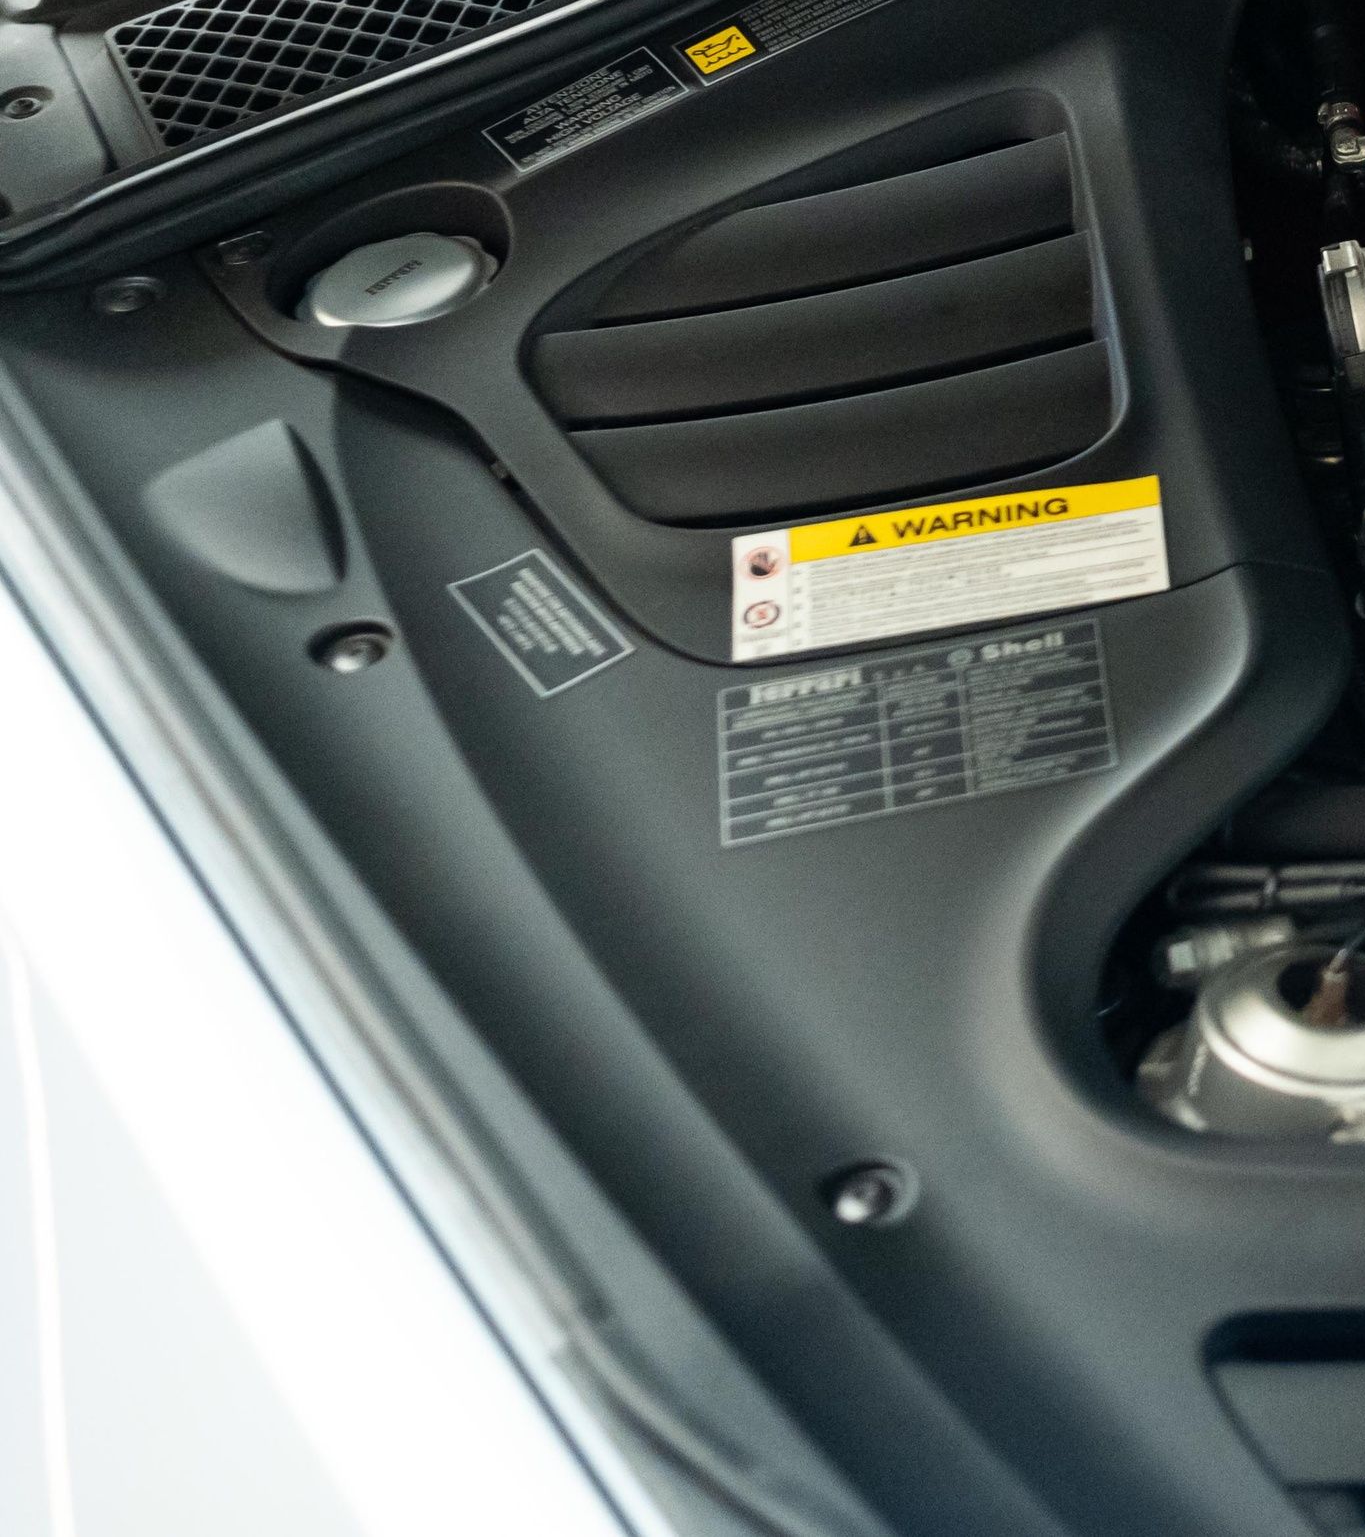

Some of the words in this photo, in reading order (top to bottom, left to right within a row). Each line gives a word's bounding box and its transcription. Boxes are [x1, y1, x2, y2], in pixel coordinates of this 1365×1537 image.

[520, 105, 555, 125] ALTA
[554, 69, 624, 107] TENSIONE
[524, 68, 610, 115] ATTENZIONE
[553, 93, 622, 130] WARNING
[543, 122, 581, 144] HIGH
[580, 91, 643, 125] VOLTAGE
[364, 259, 423, 295] Ferrari
[892, 497, 1070, 539] WARNING
[981, 630, 1065, 662] Shell
